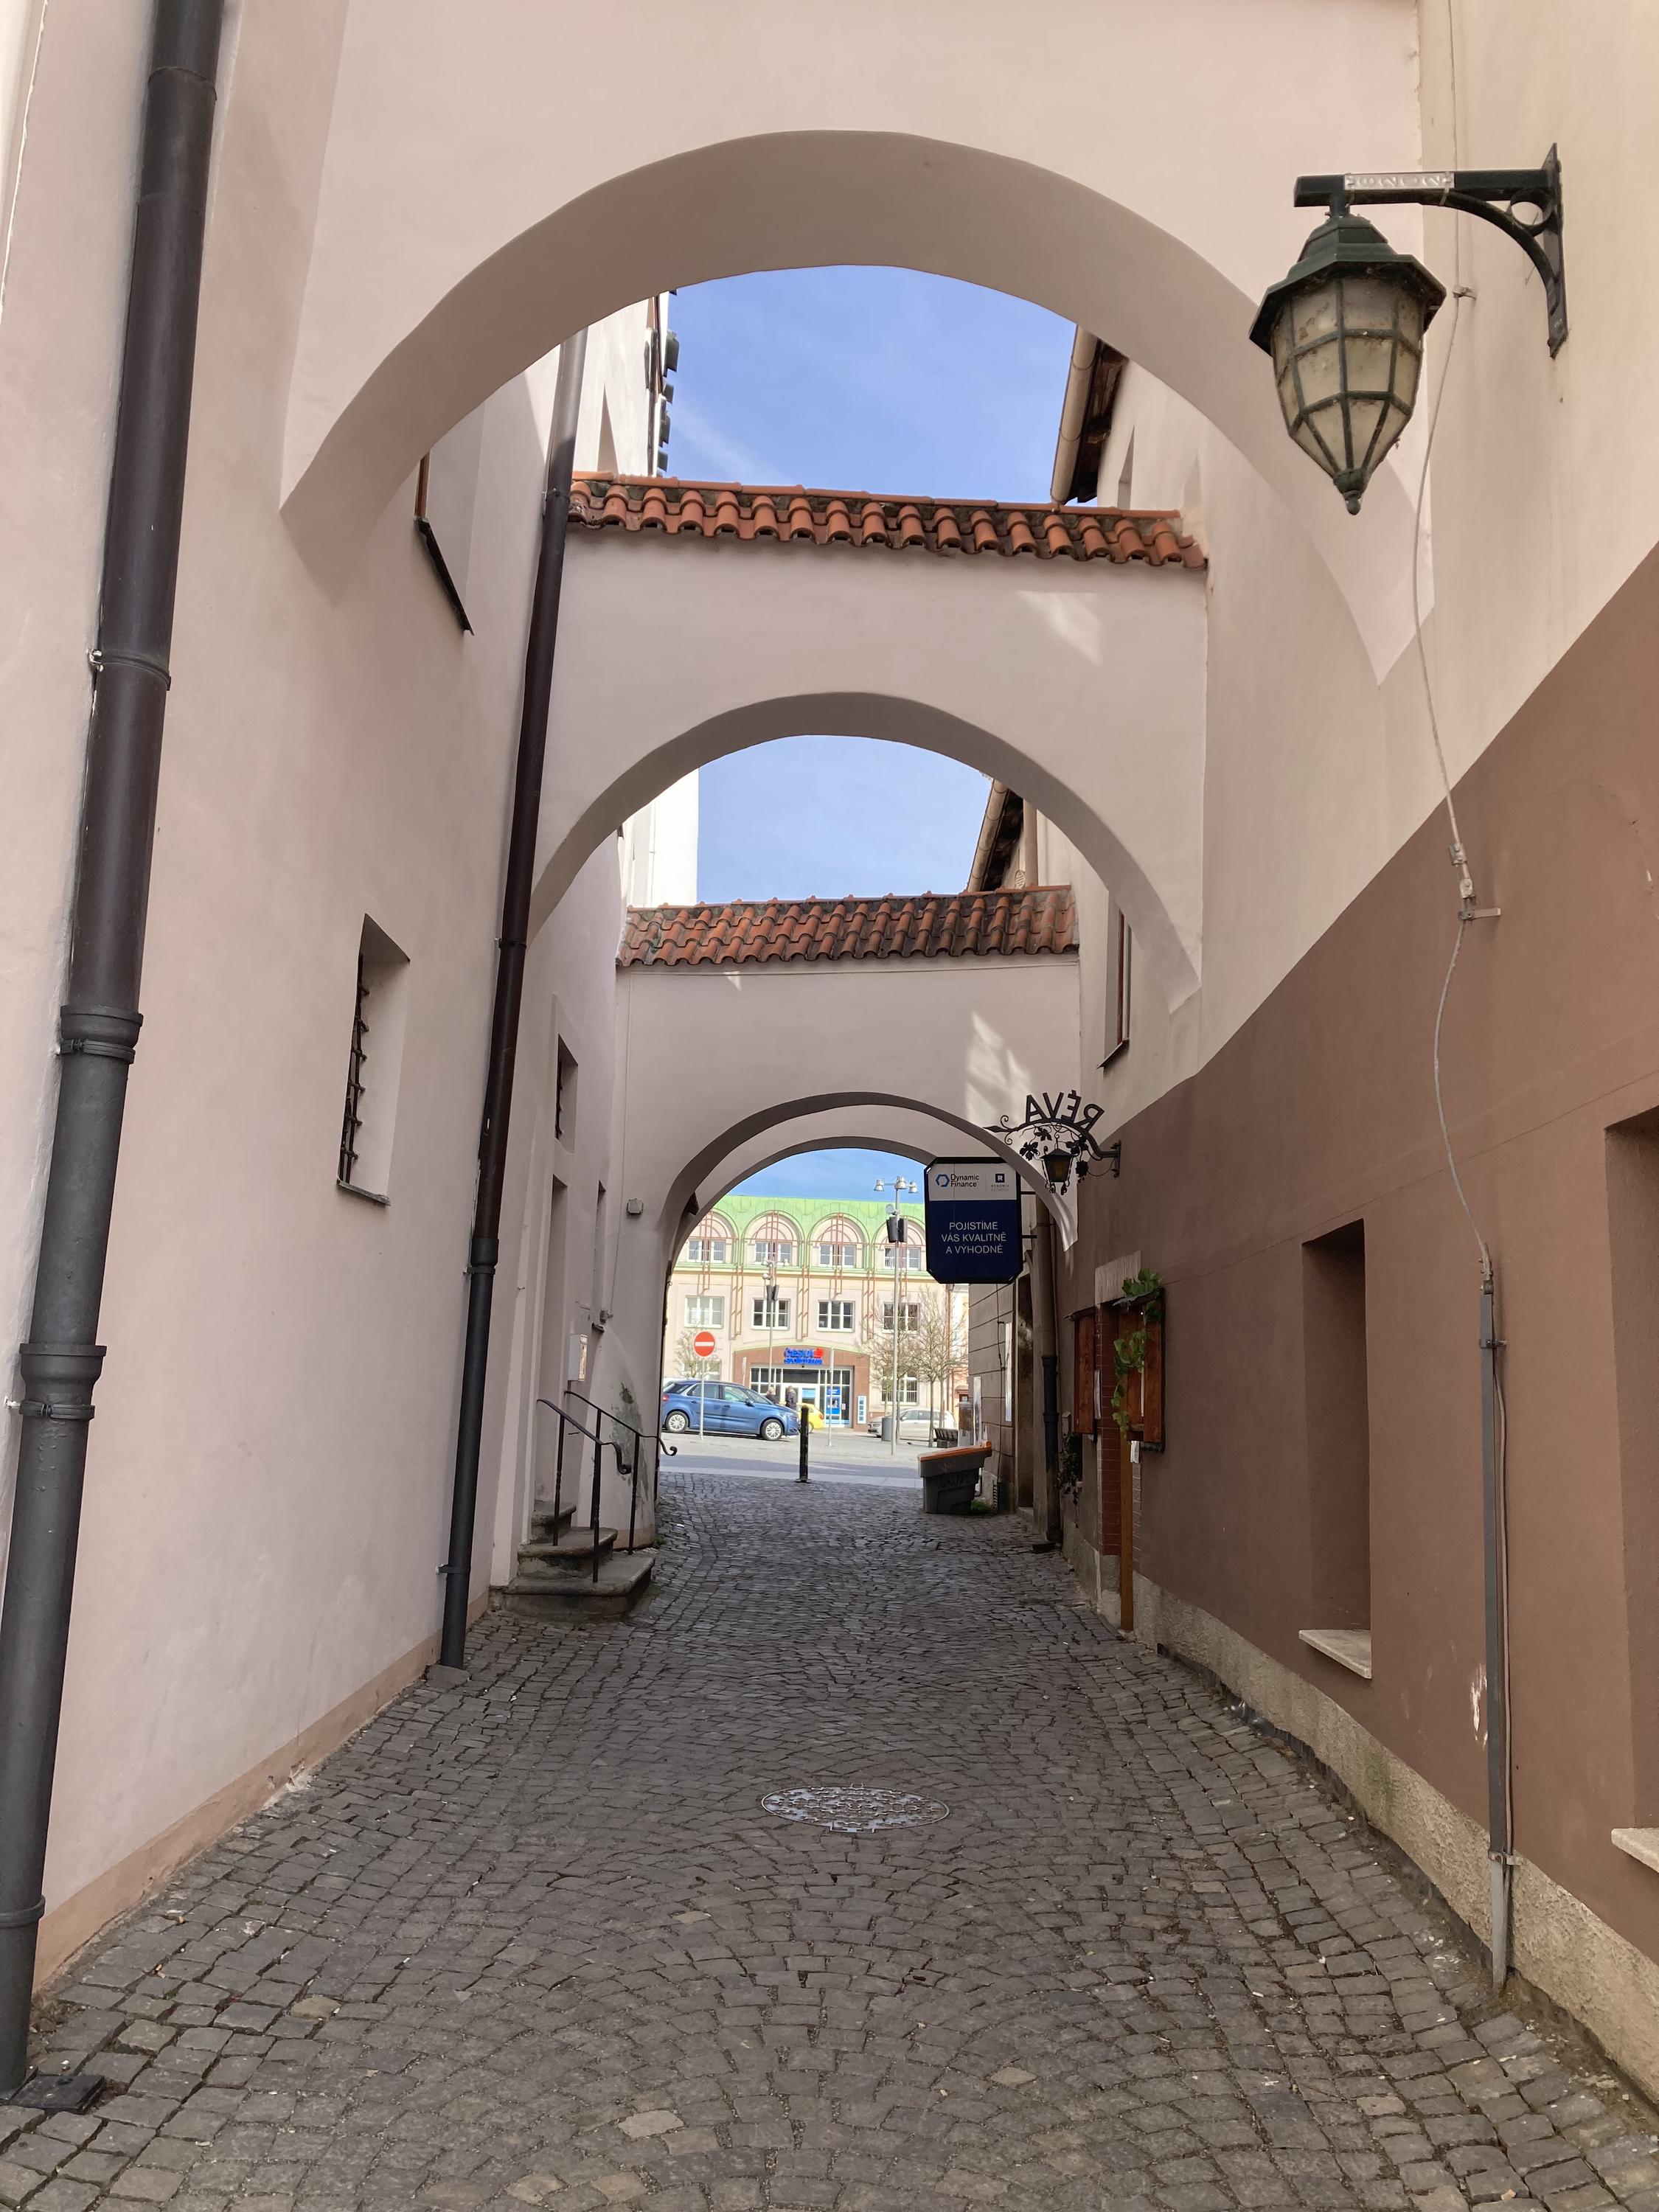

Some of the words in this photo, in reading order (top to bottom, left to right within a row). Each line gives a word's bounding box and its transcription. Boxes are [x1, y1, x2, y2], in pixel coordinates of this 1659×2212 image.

[950, 1173, 980, 1182] Dynamic
[949, 1220, 998, 1231] POJISTÍME
[941, 1232, 960, 1242] VÁS
[962, 1231, 1007, 1242] KVALITNĚ
[945, 1245, 953, 1254] A
[954, 1243, 1004, 1254] VÝHODNĚ
